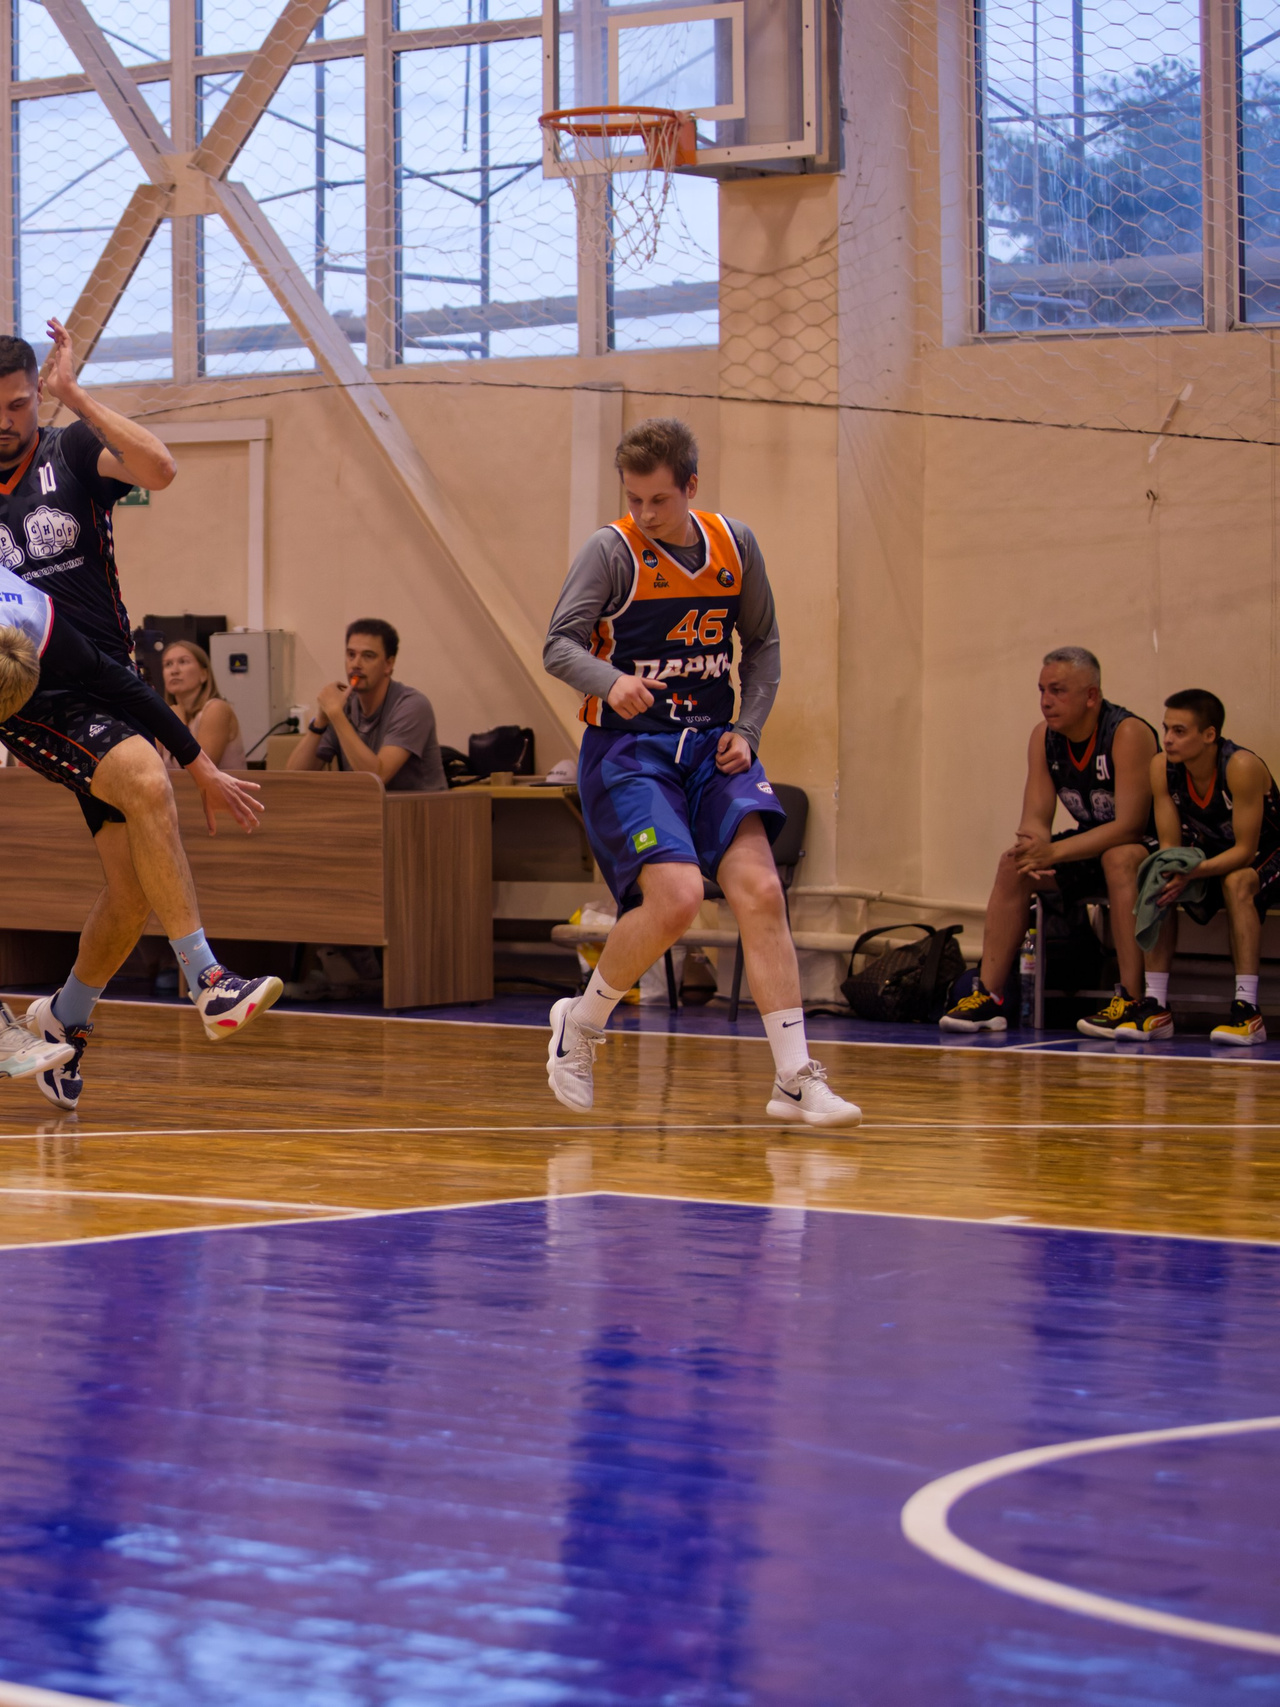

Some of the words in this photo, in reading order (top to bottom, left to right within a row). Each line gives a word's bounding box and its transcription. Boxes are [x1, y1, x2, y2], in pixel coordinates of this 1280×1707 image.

[38, 461, 57, 495] 10
[666, 608, 729, 646] 46
[1095, 754, 1111, 781] 91
